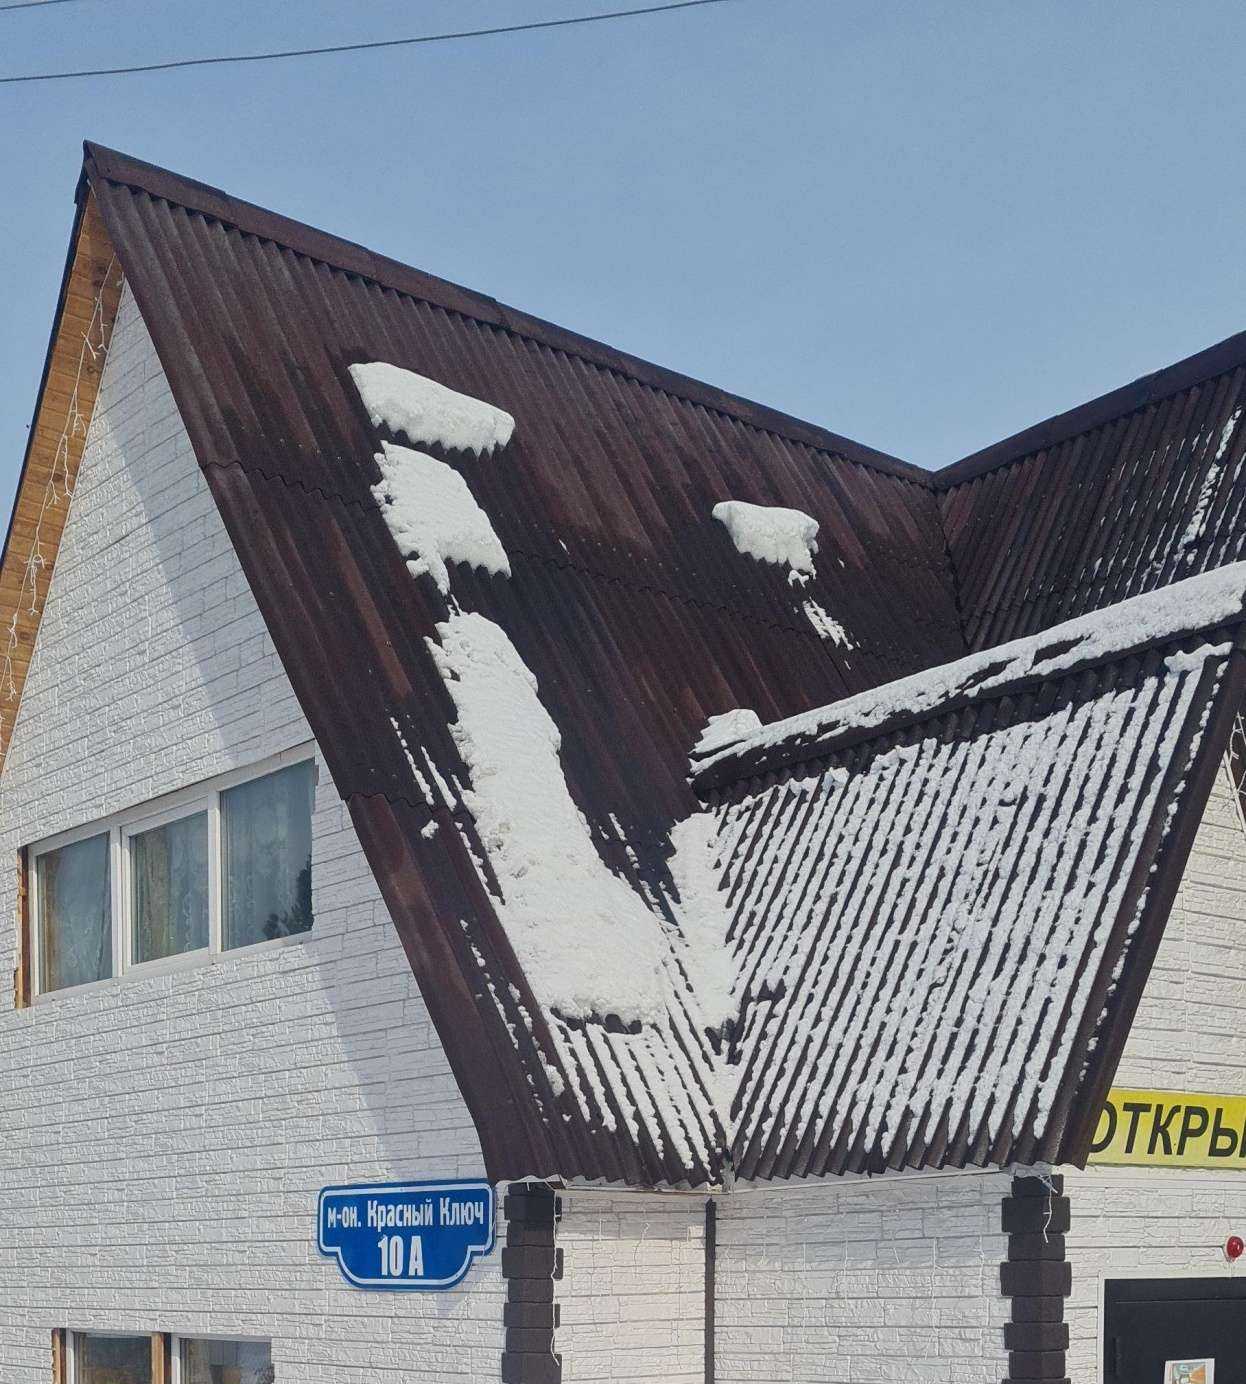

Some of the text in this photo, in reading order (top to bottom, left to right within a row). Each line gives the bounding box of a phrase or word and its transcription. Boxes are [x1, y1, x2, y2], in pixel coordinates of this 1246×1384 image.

[328, 1198, 484, 1232] м-он. Красный Ключ
[377, 1235, 424, 1276] 10 А
